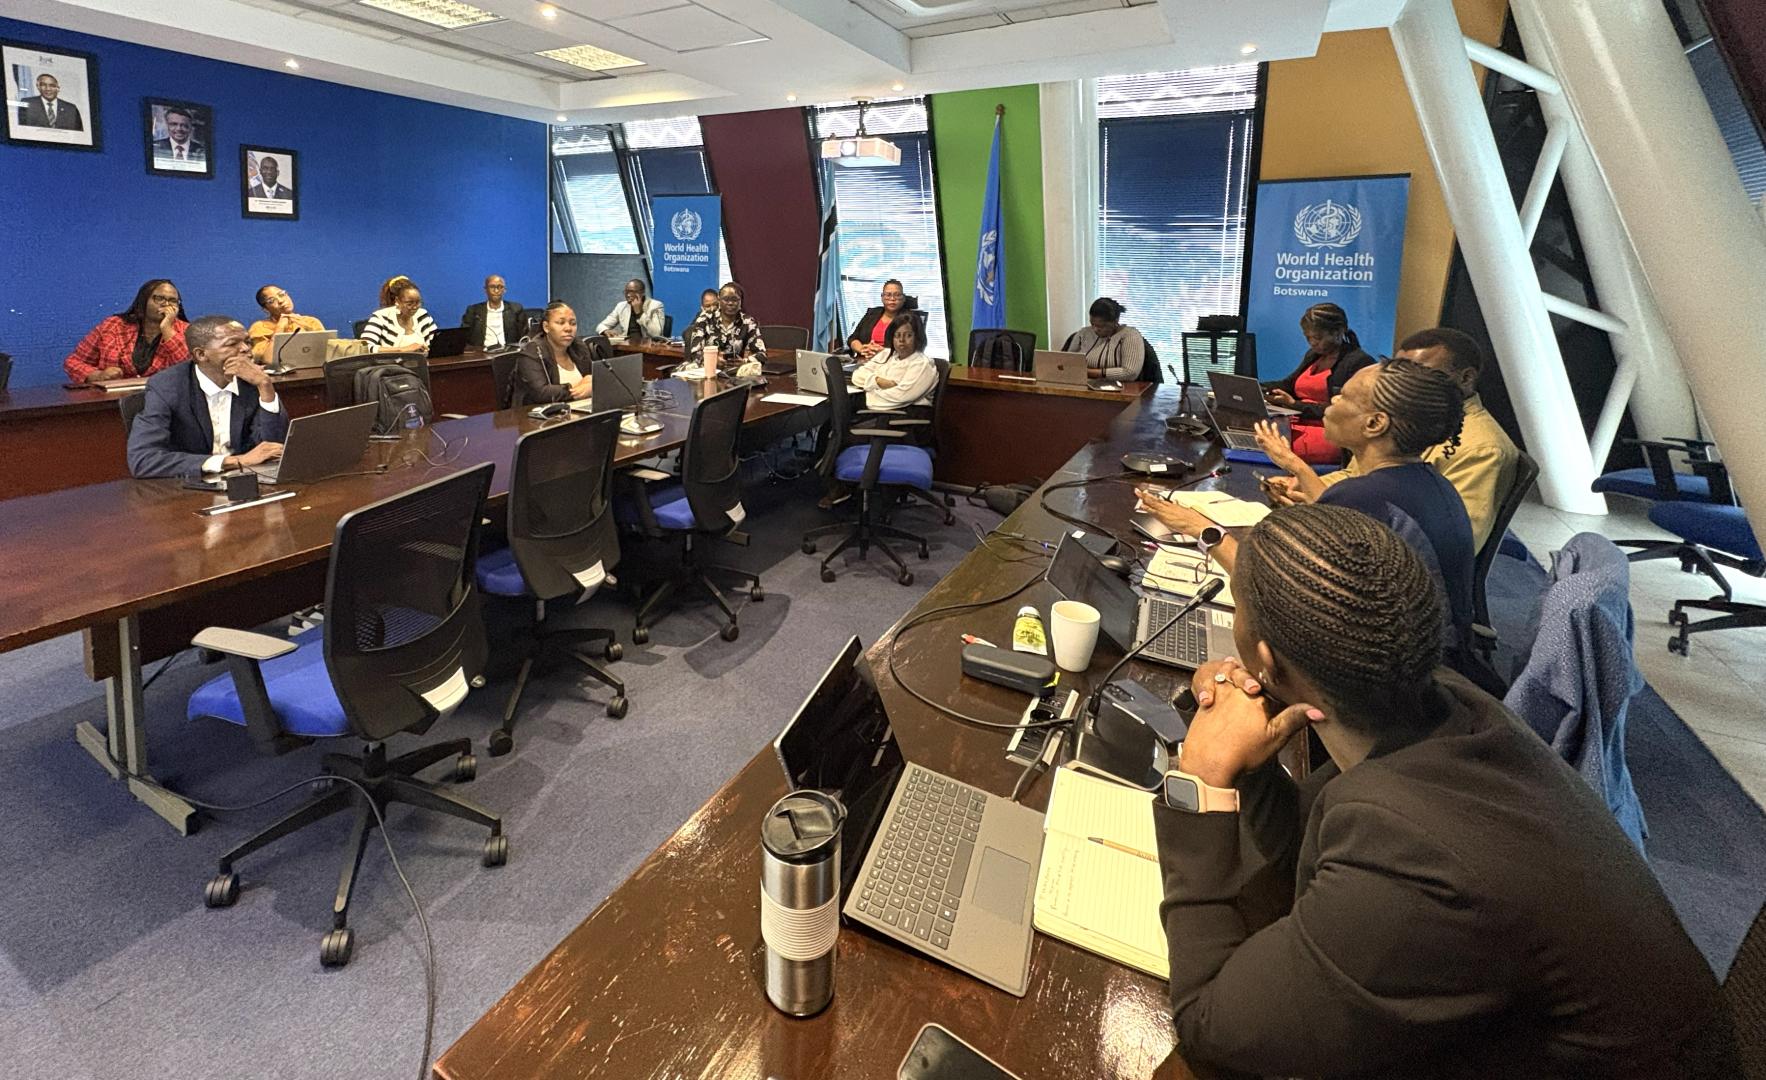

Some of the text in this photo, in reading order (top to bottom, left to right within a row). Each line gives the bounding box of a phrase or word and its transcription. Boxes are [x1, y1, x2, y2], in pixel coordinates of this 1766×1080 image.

[664, 243, 709, 253] World Health
[664, 253, 709, 263] Organization
[1277, 252, 1374, 266] World Health
[1275, 266, 1373, 282] Organization
[1273, 286, 1328, 296] Botswana
